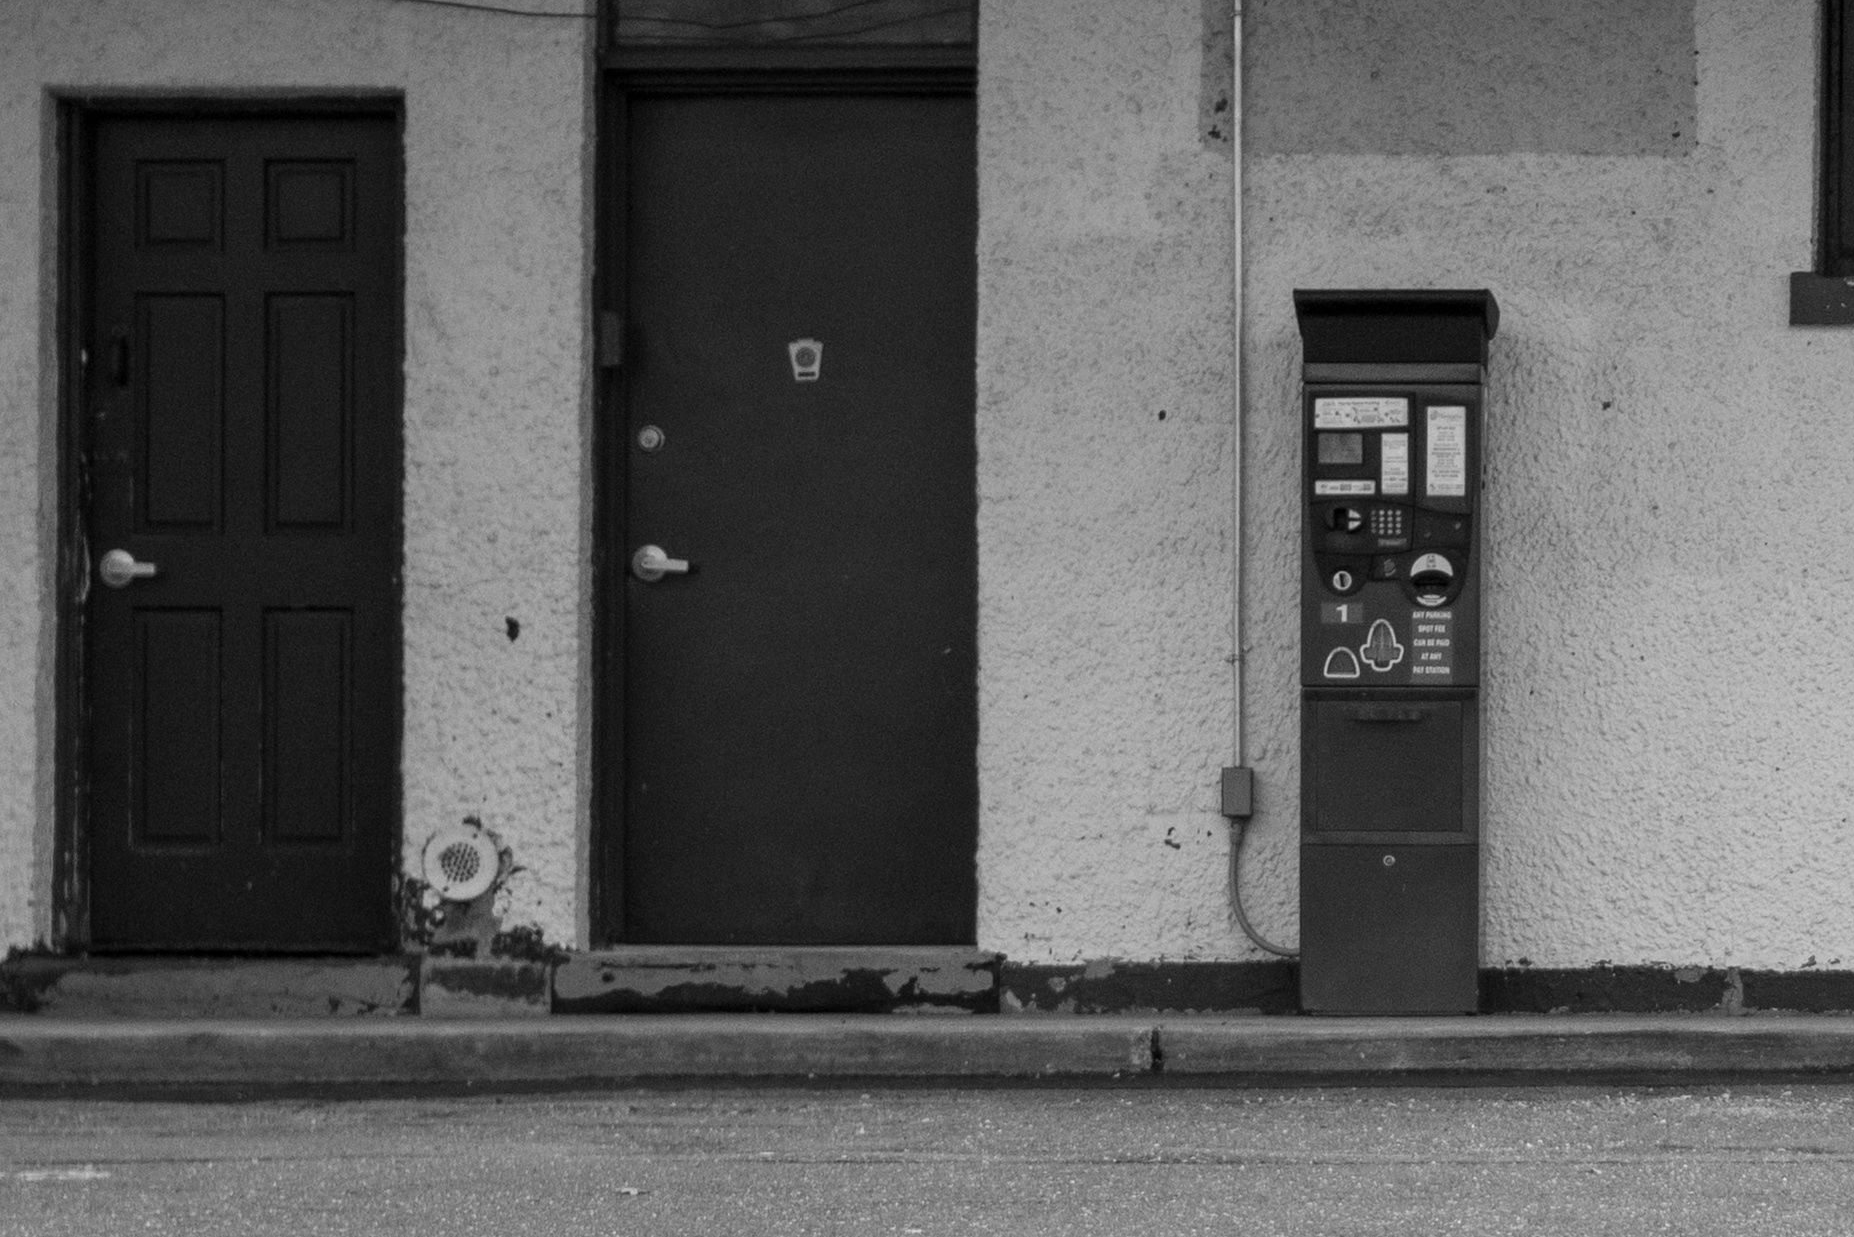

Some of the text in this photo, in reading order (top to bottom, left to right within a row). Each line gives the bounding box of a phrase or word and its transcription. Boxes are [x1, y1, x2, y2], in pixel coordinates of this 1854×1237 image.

[1336, 604, 1348, 623] 1
[1425, 611, 1452, 619] PARKING
[1421, 652, 1442, 660] AT ANY
[1425, 665, 1450, 674] STATION
